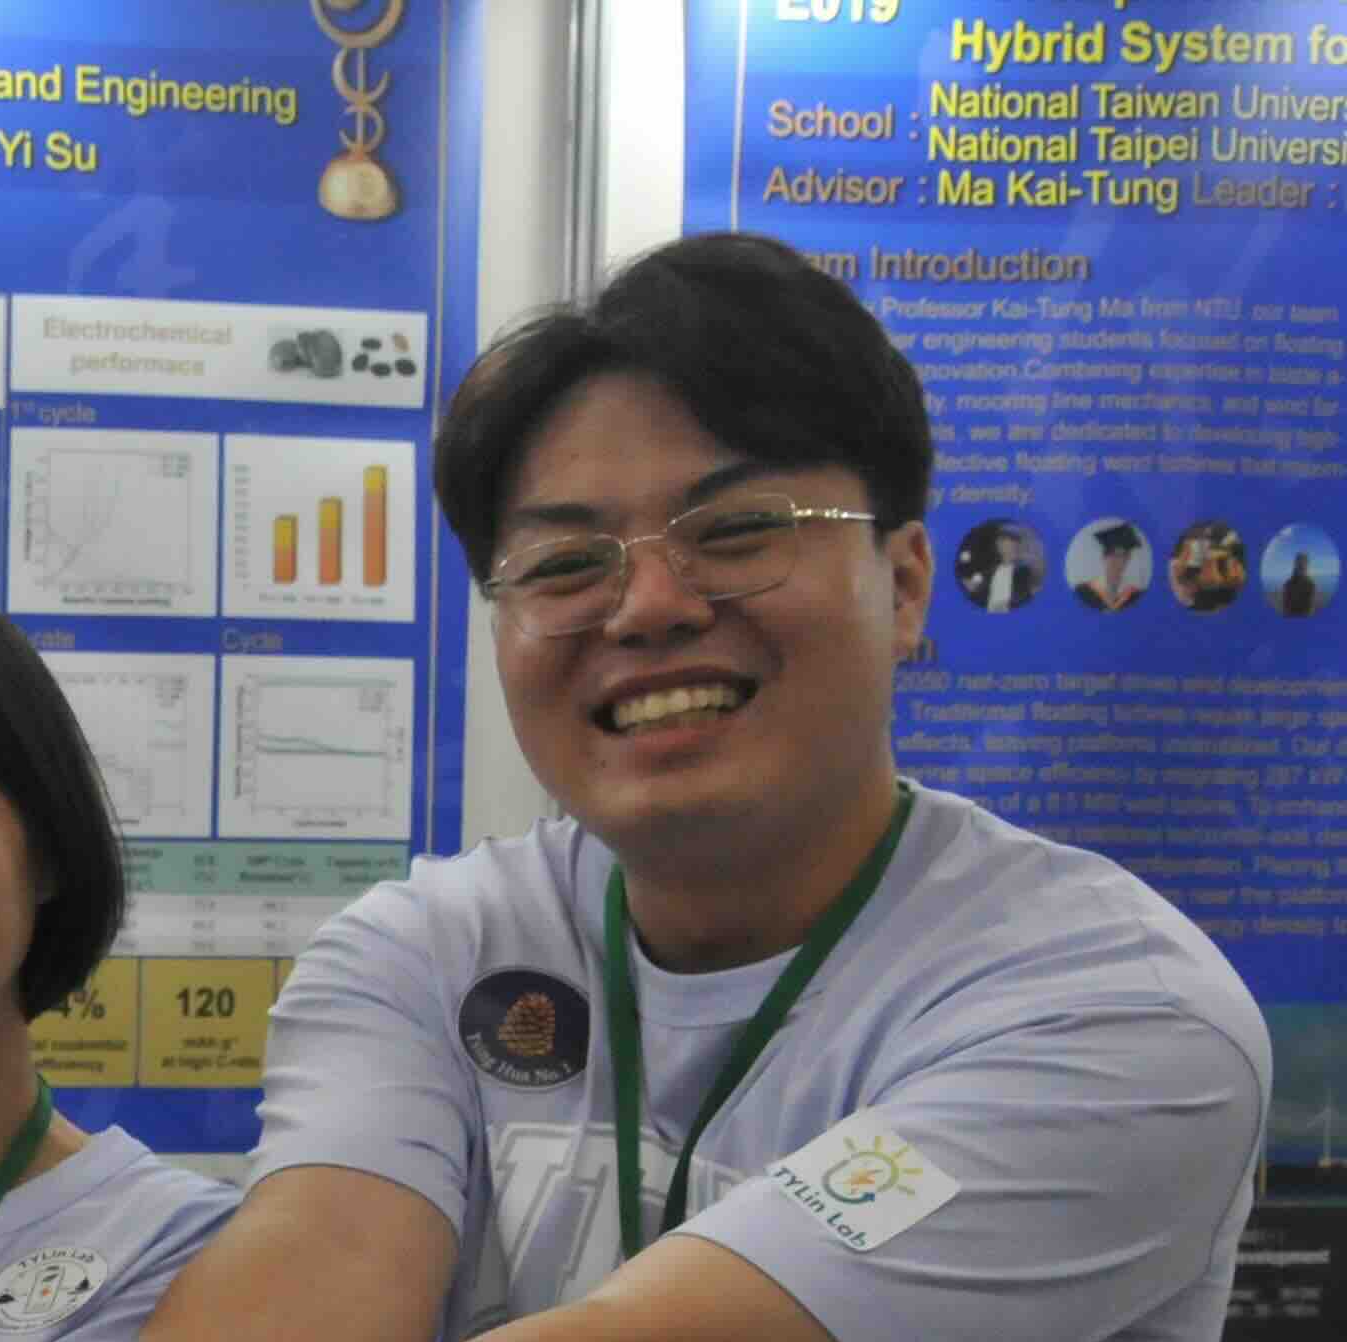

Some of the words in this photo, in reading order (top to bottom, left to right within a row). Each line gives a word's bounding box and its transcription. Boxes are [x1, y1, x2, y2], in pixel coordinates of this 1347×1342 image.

[950, 19, 1104, 72] Hybrid
[1119, 21, 1295, 73] System
[75, 66, 299, 124] Engineering
[767, 101, 896, 141] School
[929, 81, 1080, 121] National
[1091, 83, 1221, 121] Taiwan
[44, 130, 97, 172] Su
[927, 125, 1079, 164] National
[1090, 128, 1199, 167] Taipei
[763, 168, 904, 206] Advisor
[937, 170, 995, 206] Ma
[1008, 171, 1179, 213] Kai-Tung
[1193, 172, 1315, 208] Leader
[871, 246, 1091, 283] Introduction
[882, 297, 988, 321] Professor
[43, 317, 234, 347] Electrochemical
[922, 332, 1055, 356] engineering
[1059, 331, 1154, 352] students
[39, 402, 97, 427] cycle
[221, 630, 284, 655] Cycle
[176, 988, 236, 1018] 120
